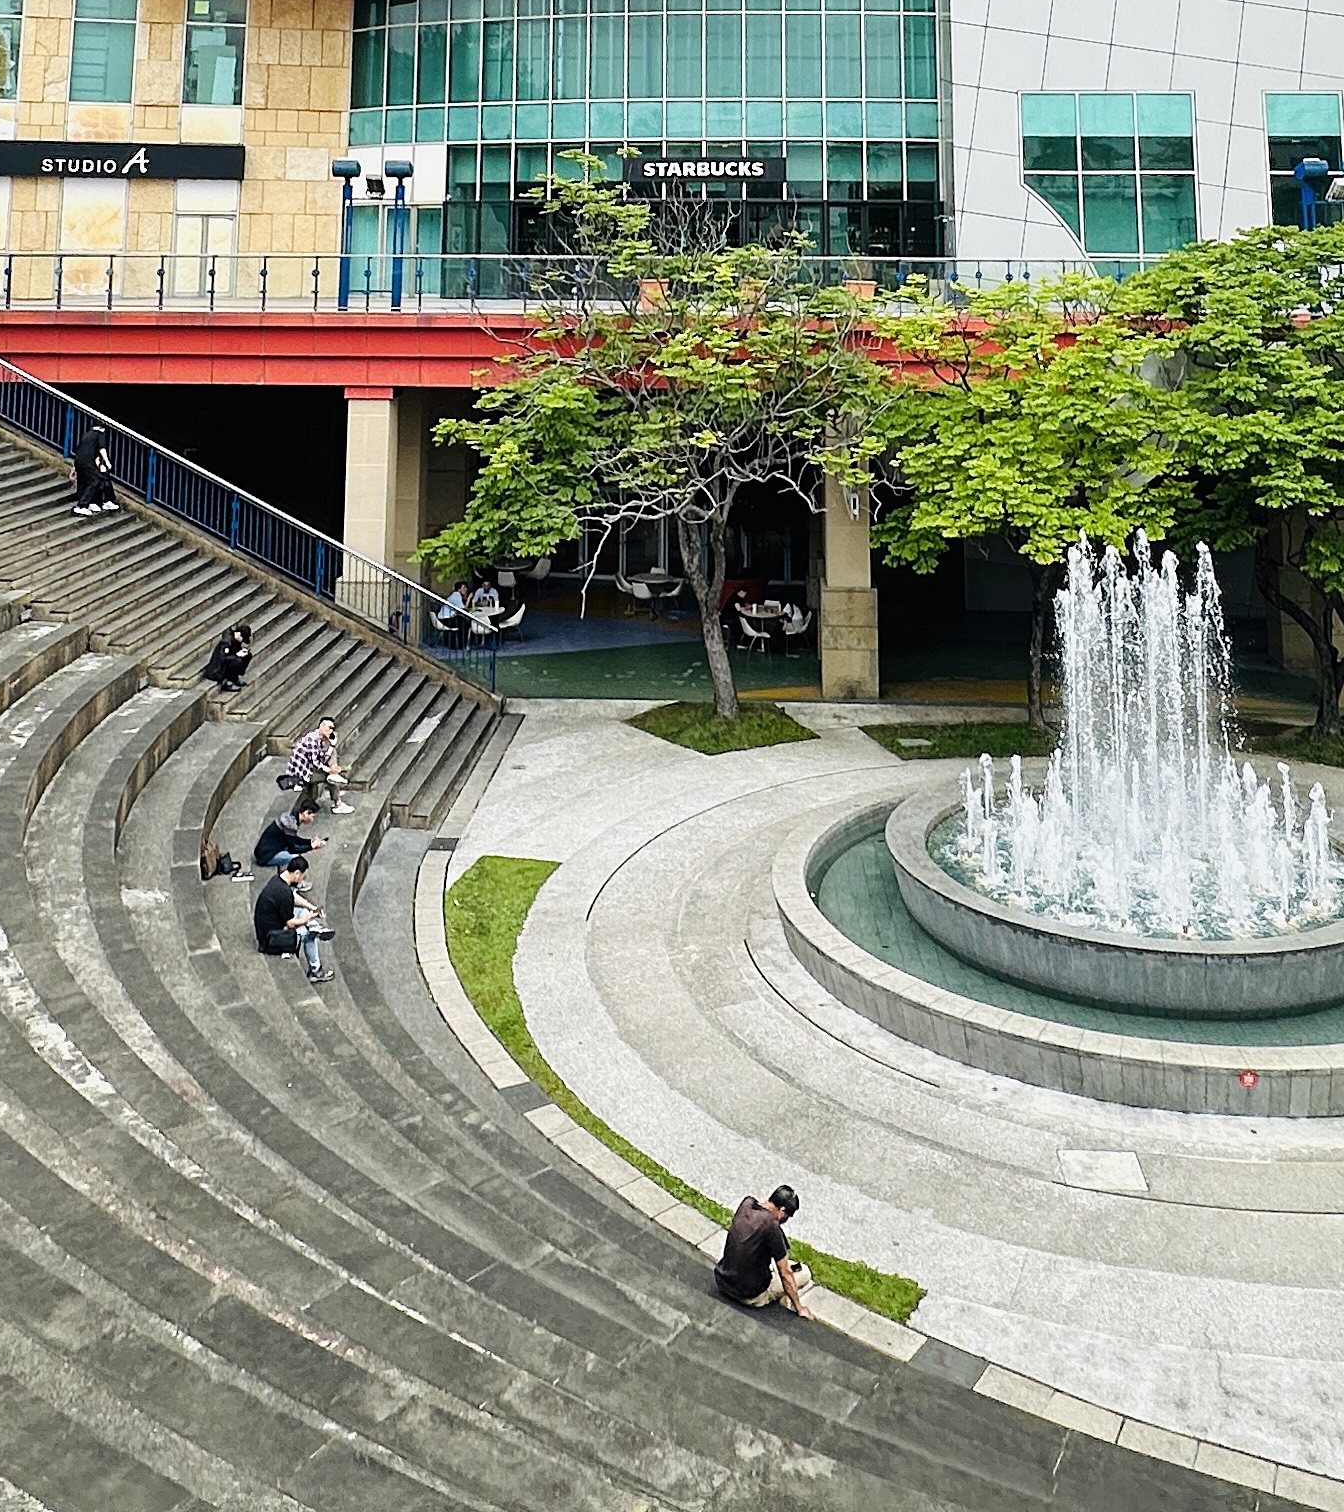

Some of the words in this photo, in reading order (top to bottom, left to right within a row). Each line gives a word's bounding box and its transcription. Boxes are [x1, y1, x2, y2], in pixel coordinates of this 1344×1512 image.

[41, 158, 118, 174] STUDIO
[121, 147, 150, 174] A
[643, 161, 765, 177] STARBUCKS
